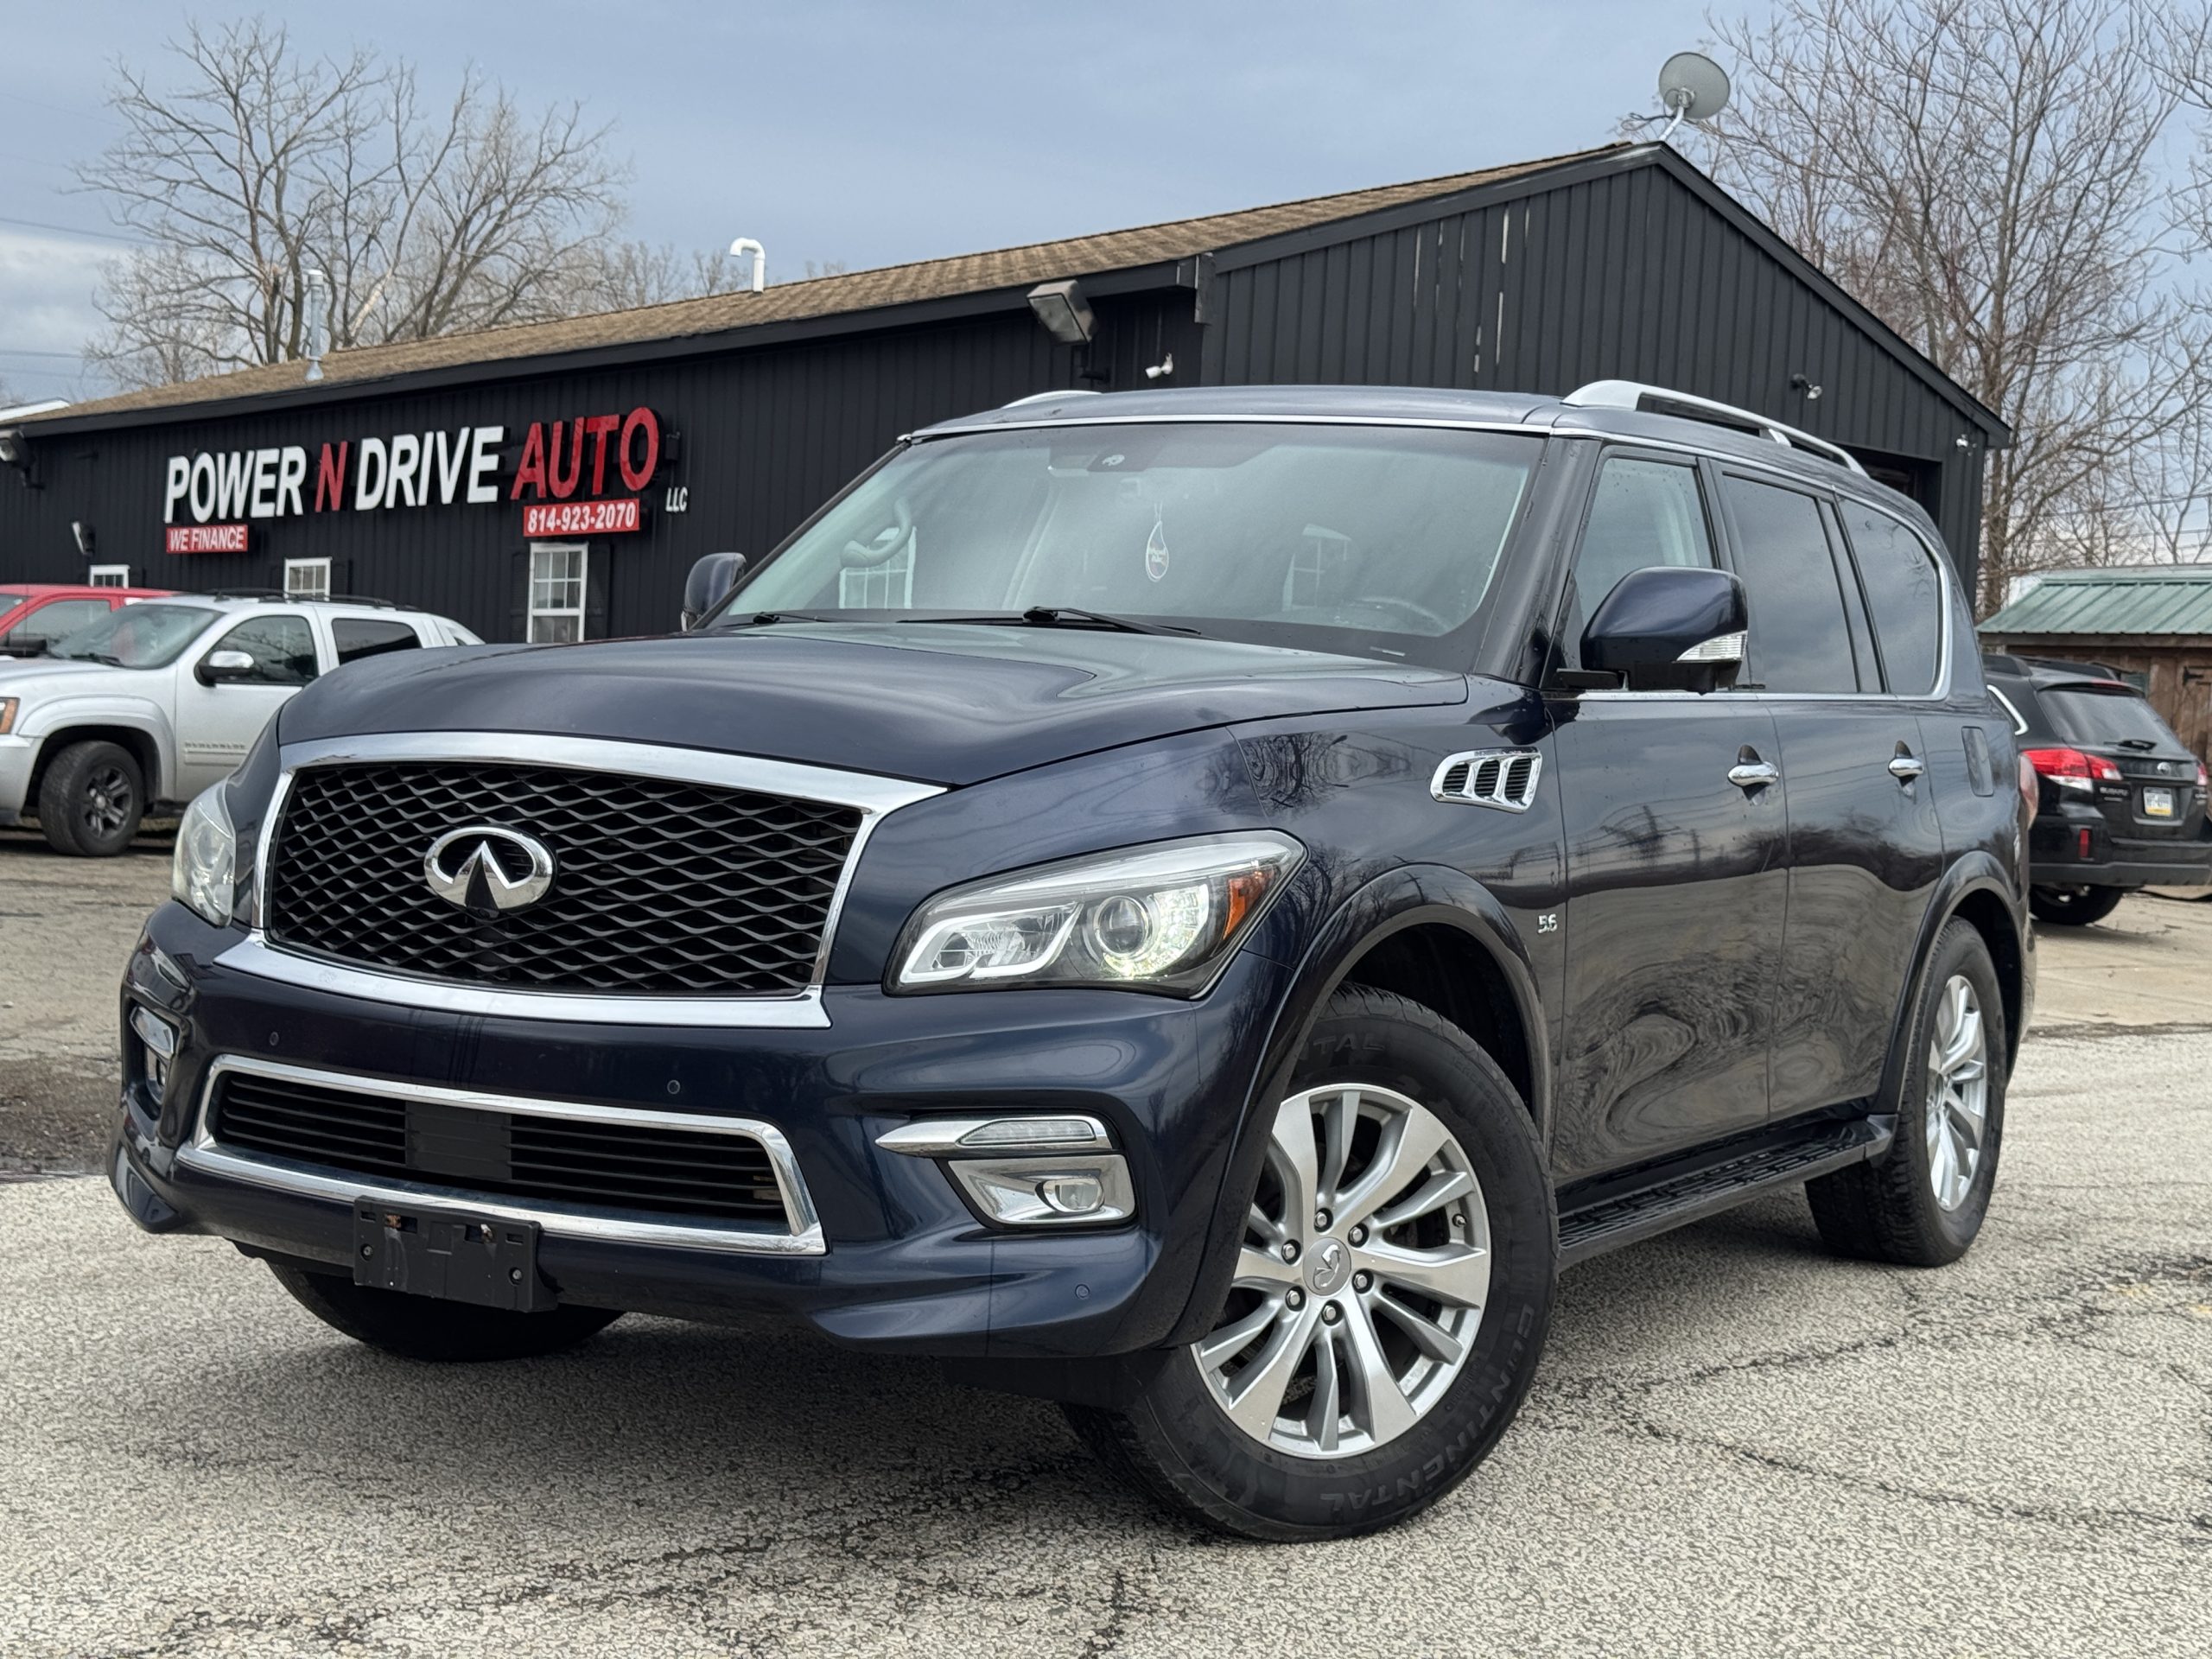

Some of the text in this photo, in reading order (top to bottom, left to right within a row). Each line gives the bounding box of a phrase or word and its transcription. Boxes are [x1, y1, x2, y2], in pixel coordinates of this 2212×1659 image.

[164, 406, 688, 524] POWER N DRIVE AUTO LLC
[528, 502, 636, 534] 814-923-2070
[170, 526, 245, 551] WE FINANCE
